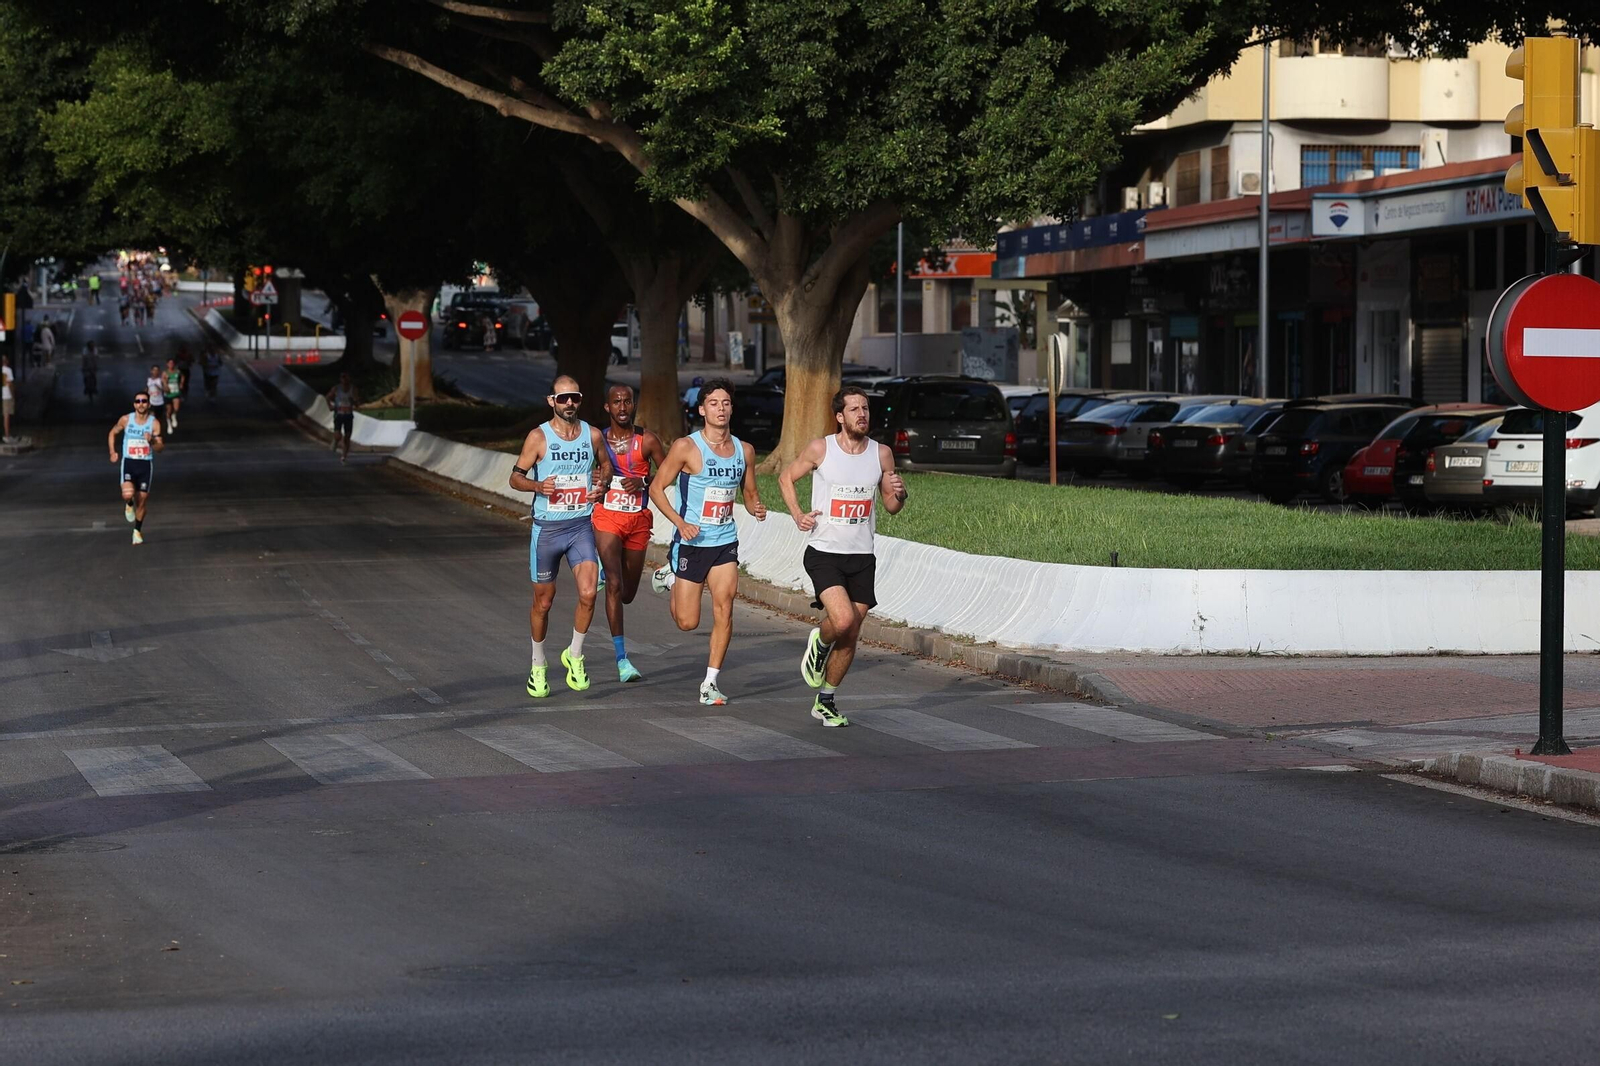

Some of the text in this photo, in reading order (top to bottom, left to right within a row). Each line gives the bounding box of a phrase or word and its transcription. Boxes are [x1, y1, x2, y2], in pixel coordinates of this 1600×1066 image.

[1466, 188, 1496, 215] RE/MAX
[128, 428, 145, 436] nerj
[551, 448, 589, 463] nerja
[708, 465, 743, 480] nerja
[556, 491, 582, 505] 207
[612, 492, 637, 506] 250
[711, 505, 730, 519] 190
[839, 504, 865, 518] 170
